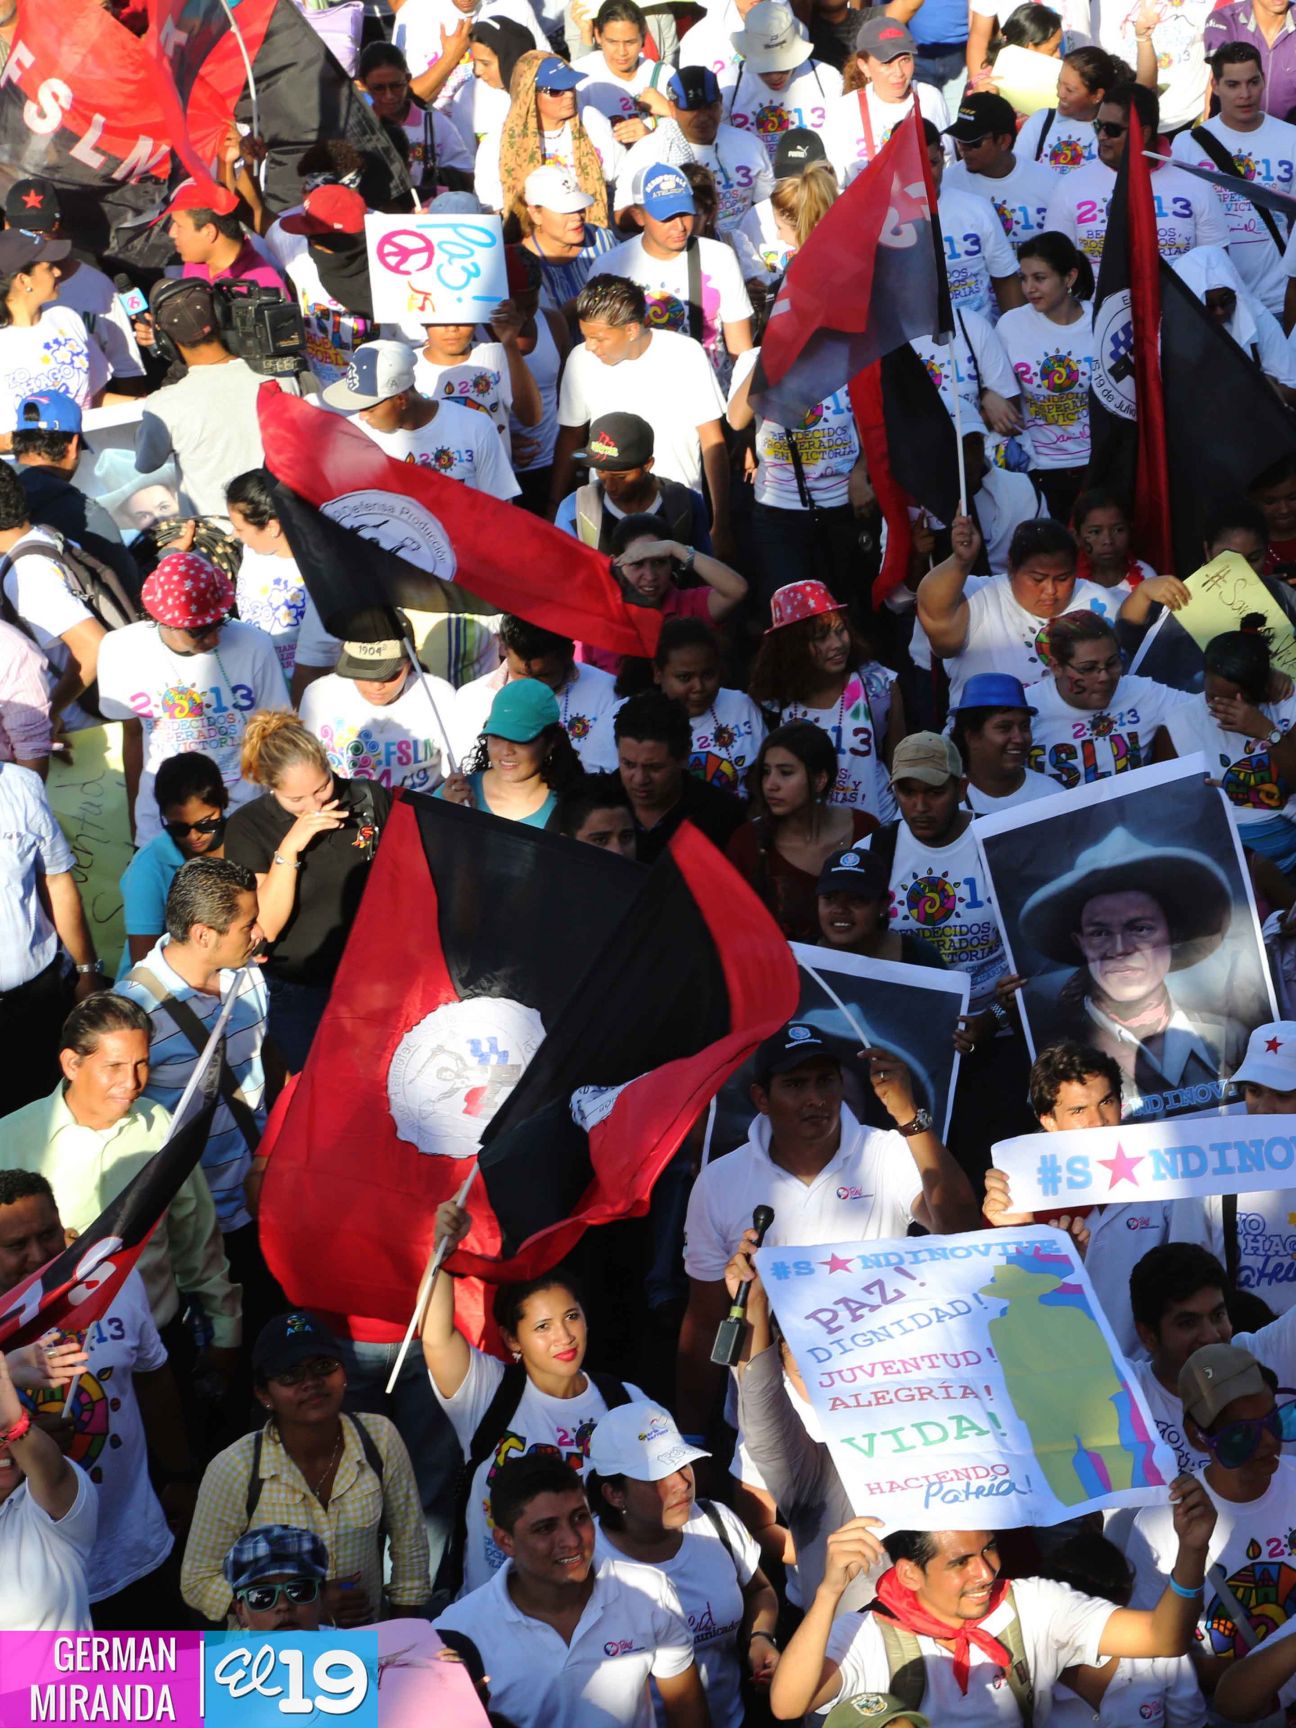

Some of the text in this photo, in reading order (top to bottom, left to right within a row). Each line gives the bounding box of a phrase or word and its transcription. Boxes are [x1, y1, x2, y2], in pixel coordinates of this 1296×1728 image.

[0, 40, 171, 184] FSLN
[804, 1265, 928, 1336] PAZ!
[806, 1292, 989, 1364] DIGNIDAD!
[818, 1347, 999, 1389] JUVENTUD!
[828, 1381, 994, 1412] ALEGRÍA!
[840, 1411, 1009, 1459] VIDA!
[865, 1463, 1010, 1496] HACIENDO
